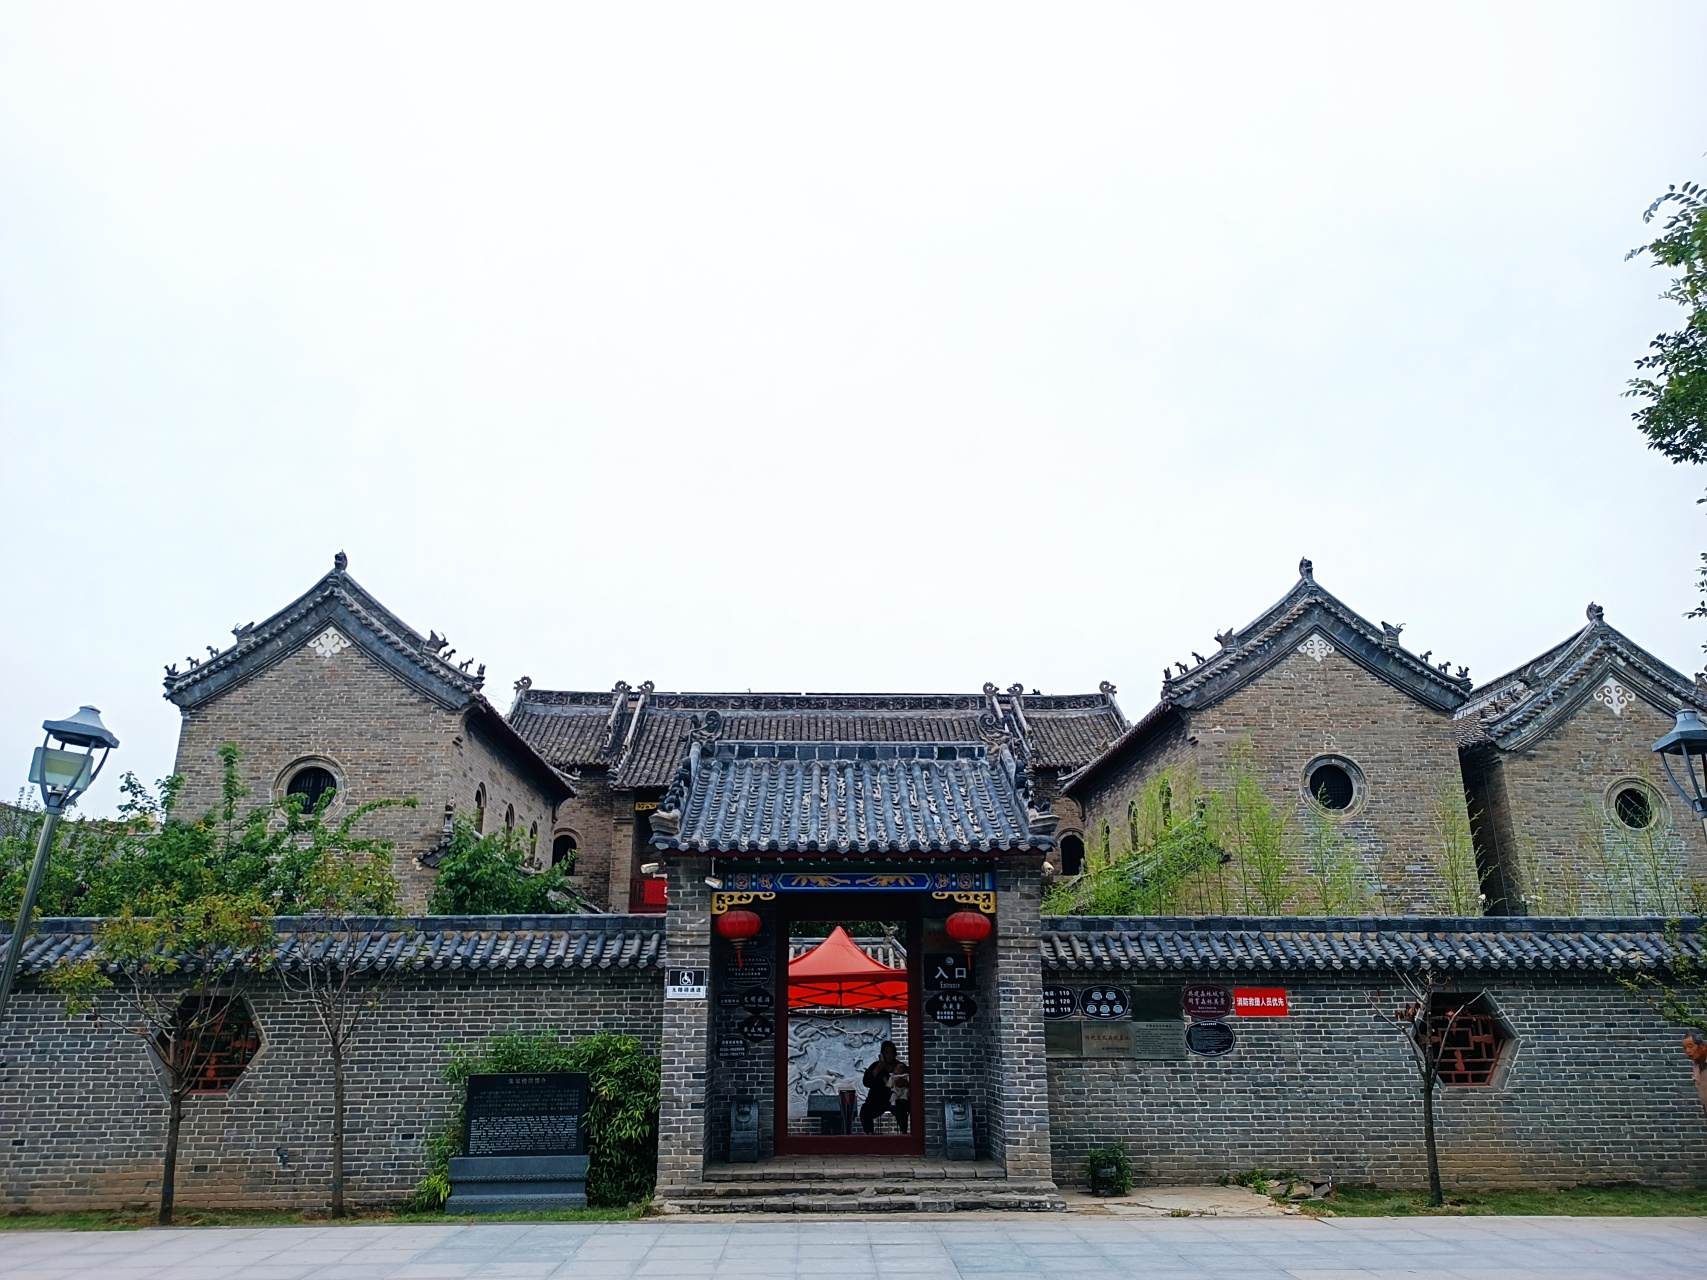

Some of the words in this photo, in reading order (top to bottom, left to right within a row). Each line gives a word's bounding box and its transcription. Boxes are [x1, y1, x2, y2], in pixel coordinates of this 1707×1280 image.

[934, 966, 967, 979] 入口
[939, 981, 961, 989] Entrance
[1187, 989, 1226, 998] 共建森林城市
[1236, 997, 1285, 1007] 消防救援人员优先
